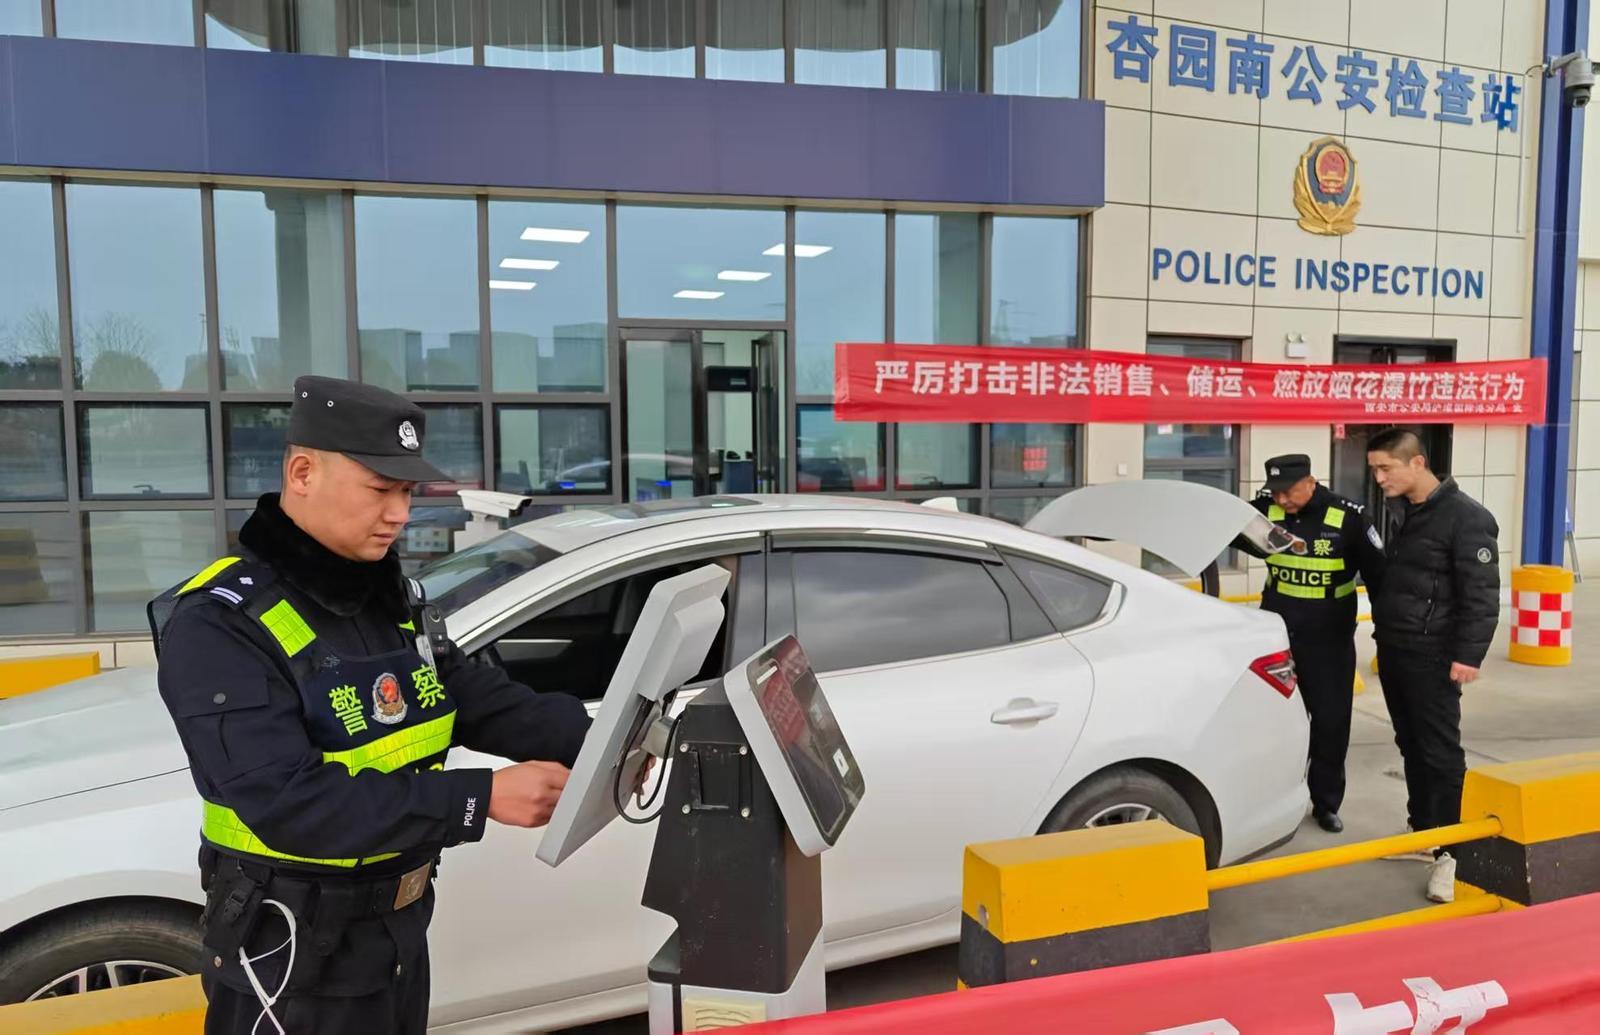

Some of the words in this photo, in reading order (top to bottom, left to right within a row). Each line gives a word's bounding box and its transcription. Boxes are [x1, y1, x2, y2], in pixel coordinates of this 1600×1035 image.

[1107, 16, 1522, 132] 杏园南公安检查站
[1152, 247, 1277, 289] POLICE
[1295, 259, 1484, 299] INSPECTION
[874, 359, 1525, 401] 严厉打击非法销售、储运、燃放烟花爆竹违法行为
[1314, 539, 1331, 555] 察
[1271, 566, 1332, 585] POLICE
[464, 797, 476, 826] POLICE
